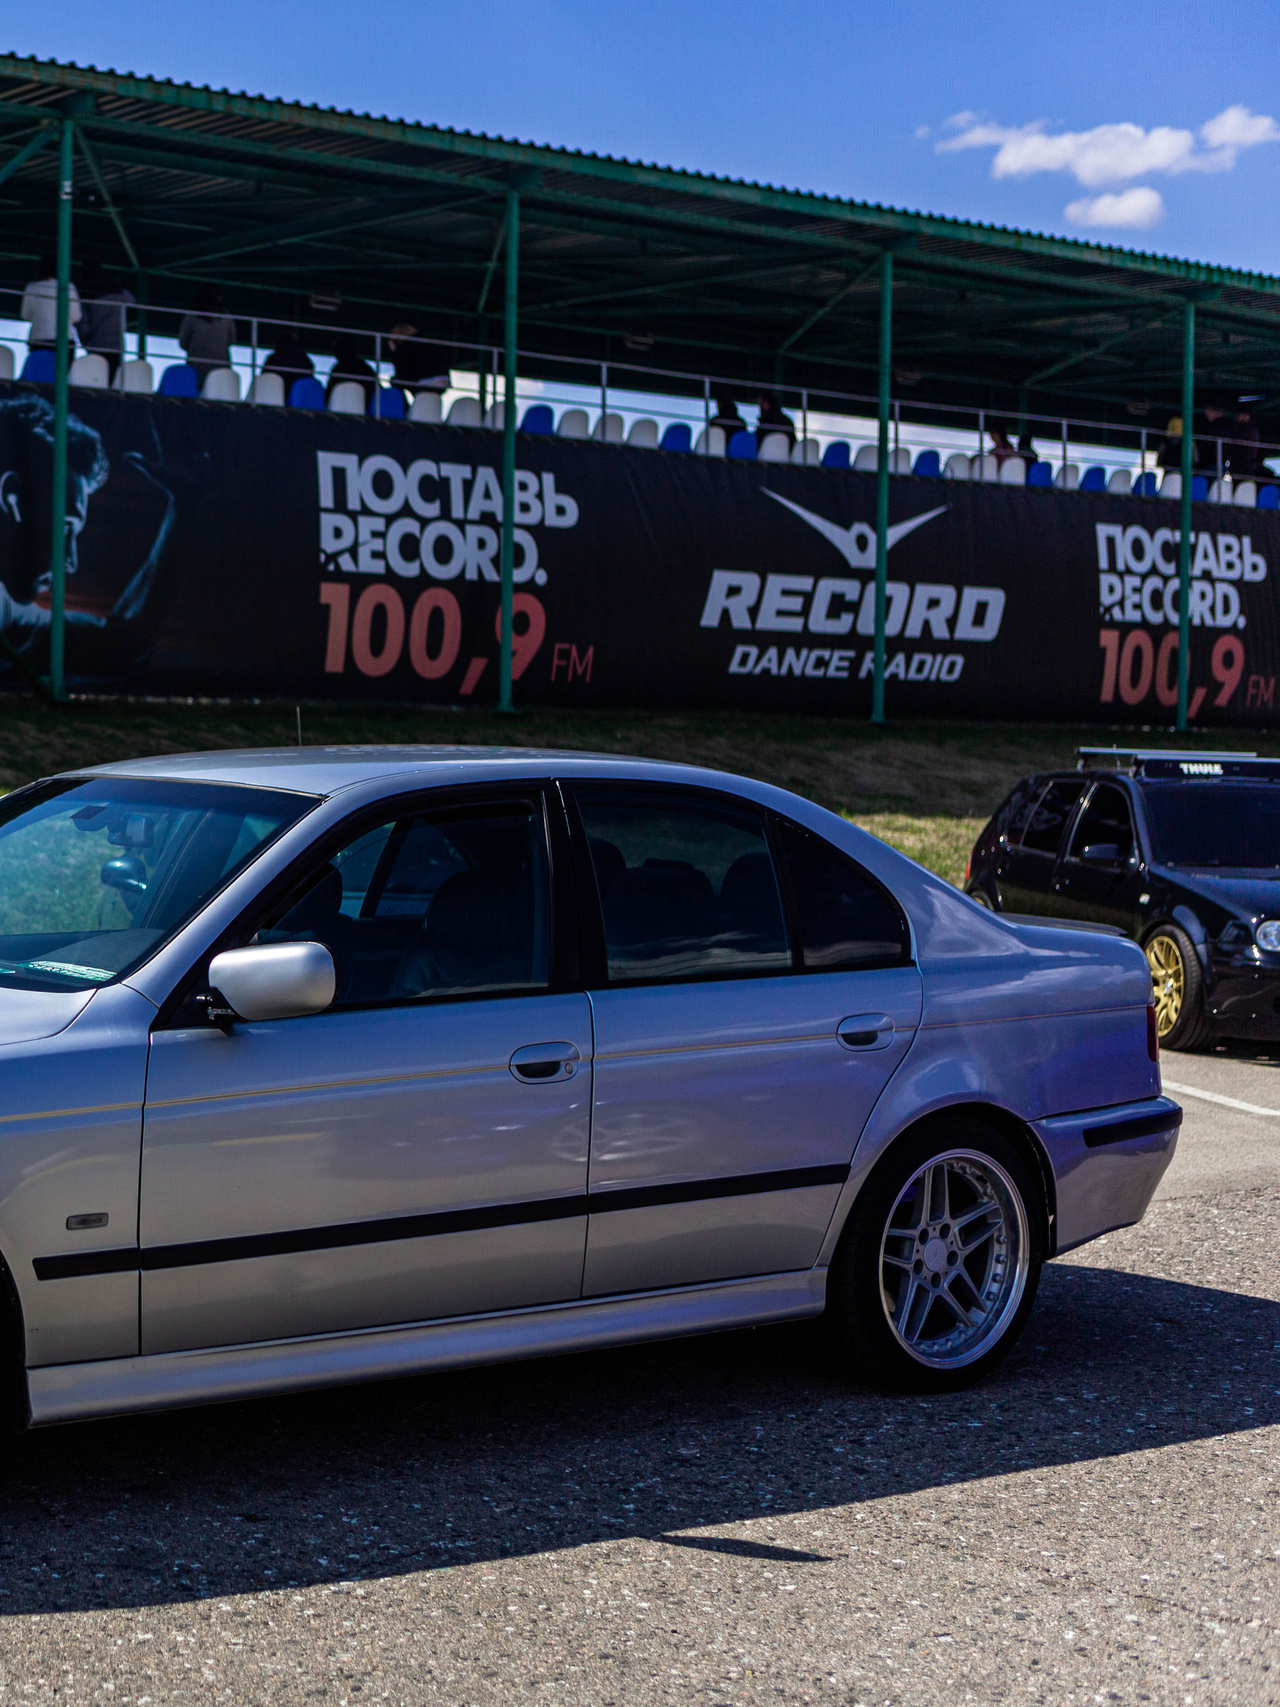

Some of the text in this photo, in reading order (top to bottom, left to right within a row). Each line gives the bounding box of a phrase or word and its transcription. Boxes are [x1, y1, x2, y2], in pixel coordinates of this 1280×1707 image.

[317, 451, 579, 528] ПОСТАВЬ
[320, 582, 595, 695] 100,9 FM
[700, 568, 1007, 642] RECORD
[728, 644, 856, 679] DANCE
[1098, 628, 1276, 720] 100,9 FM
[1179, 763, 1223, 775] THULE
